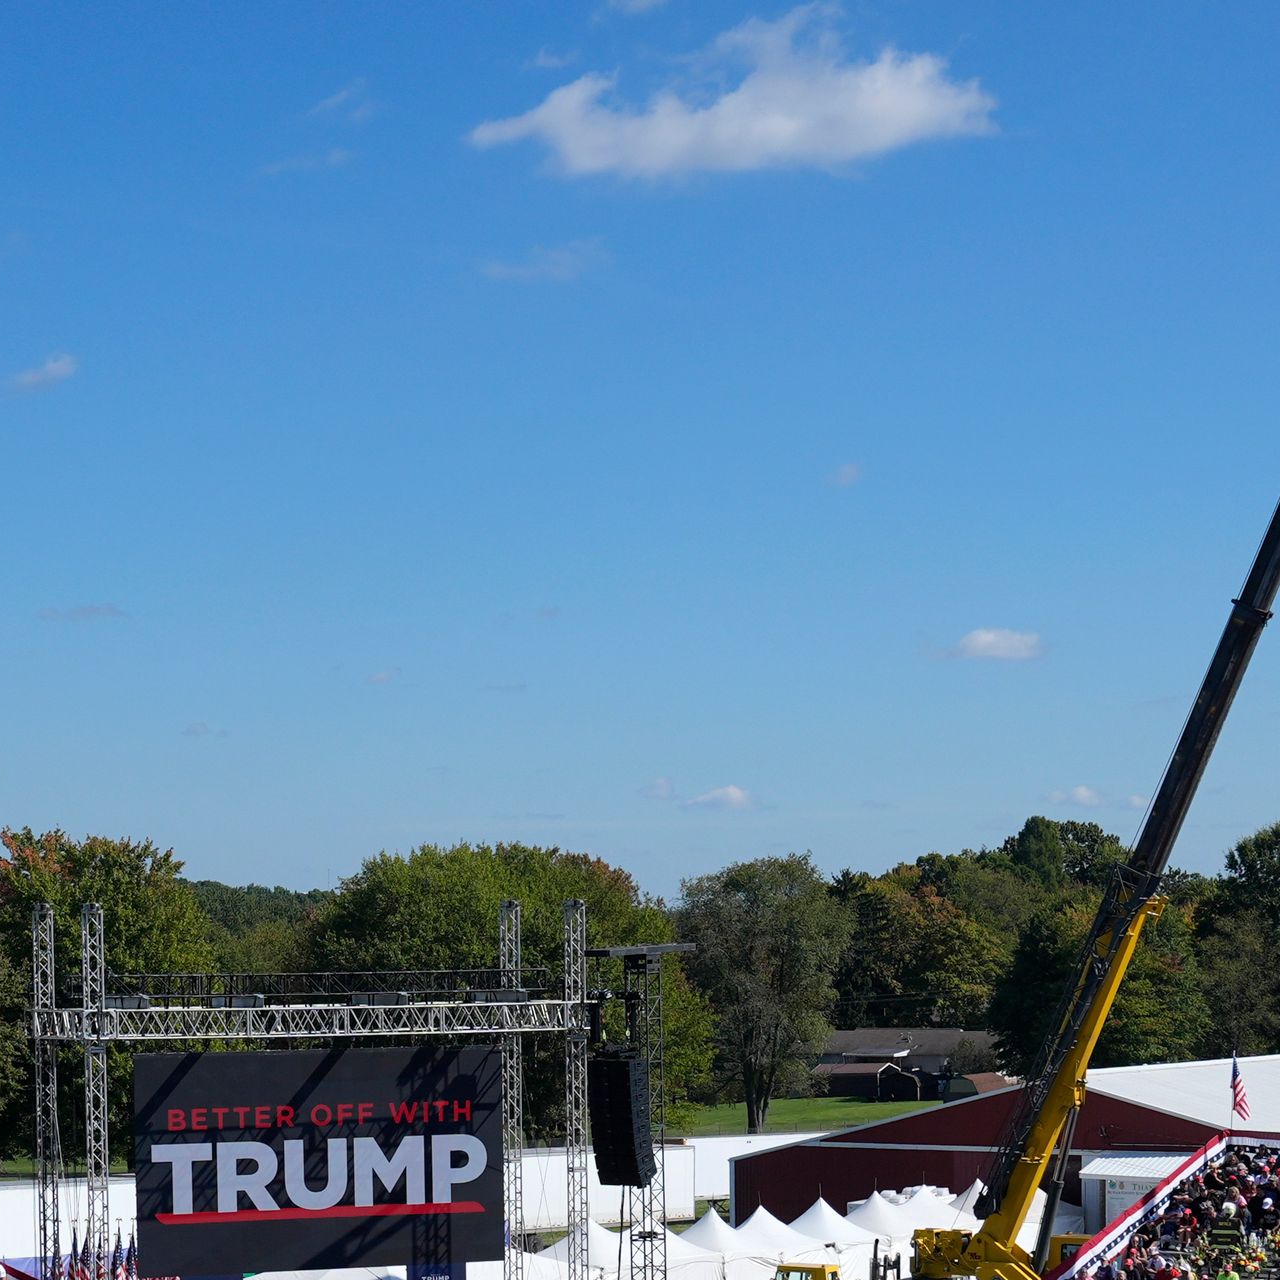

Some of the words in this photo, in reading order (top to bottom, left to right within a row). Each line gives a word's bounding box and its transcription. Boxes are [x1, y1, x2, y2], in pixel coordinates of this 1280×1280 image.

[167, 1105, 295, 1131] BETTER
[311, 1103, 373, 1126] OFF
[389, 1099, 472, 1124] WITH
[151, 1133, 488, 1214] TRUMP
